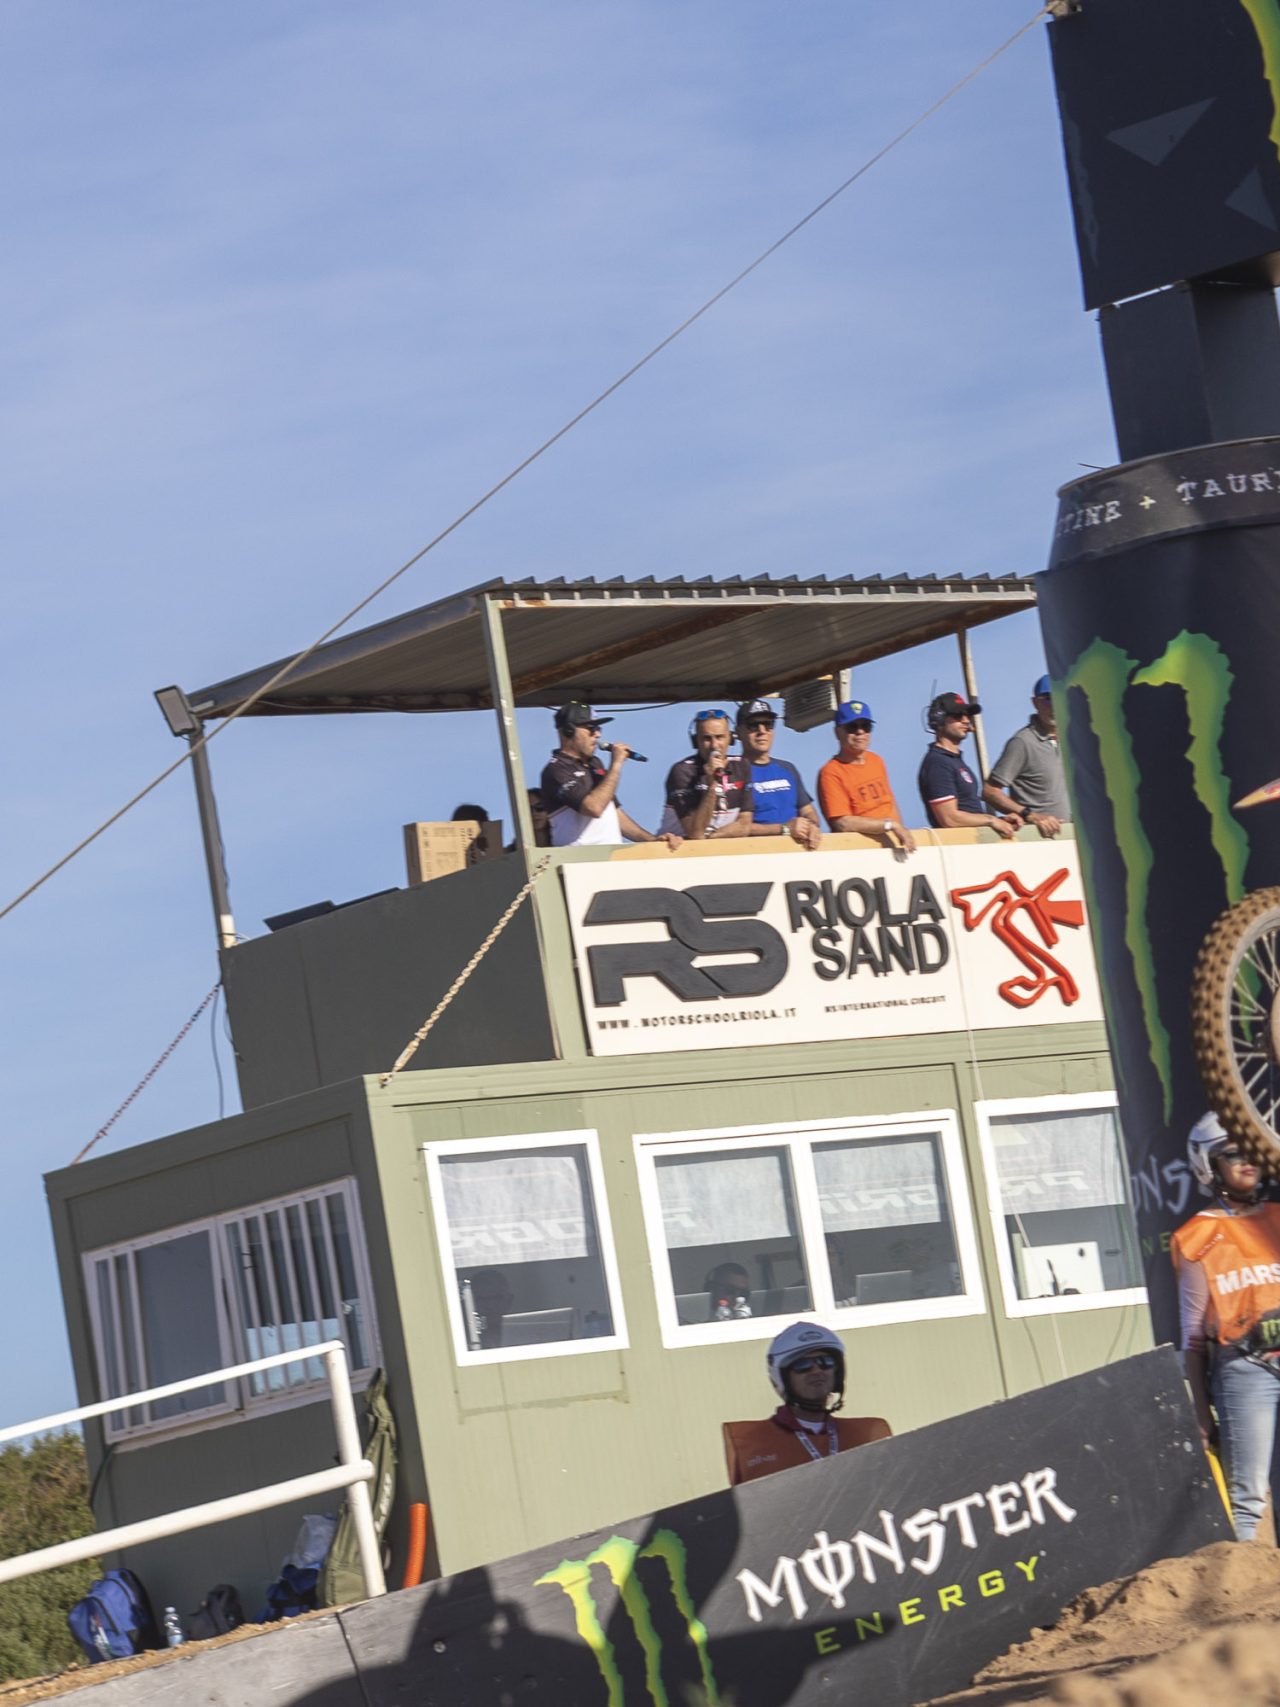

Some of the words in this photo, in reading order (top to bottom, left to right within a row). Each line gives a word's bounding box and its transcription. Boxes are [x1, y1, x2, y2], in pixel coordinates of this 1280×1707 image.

[784, 874, 945, 933] RIOLA
[811, 922, 950, 981] SAND
[736, 1466, 1078, 1622] MONSTER
[814, 1555, 1040, 1656] ENERGY
